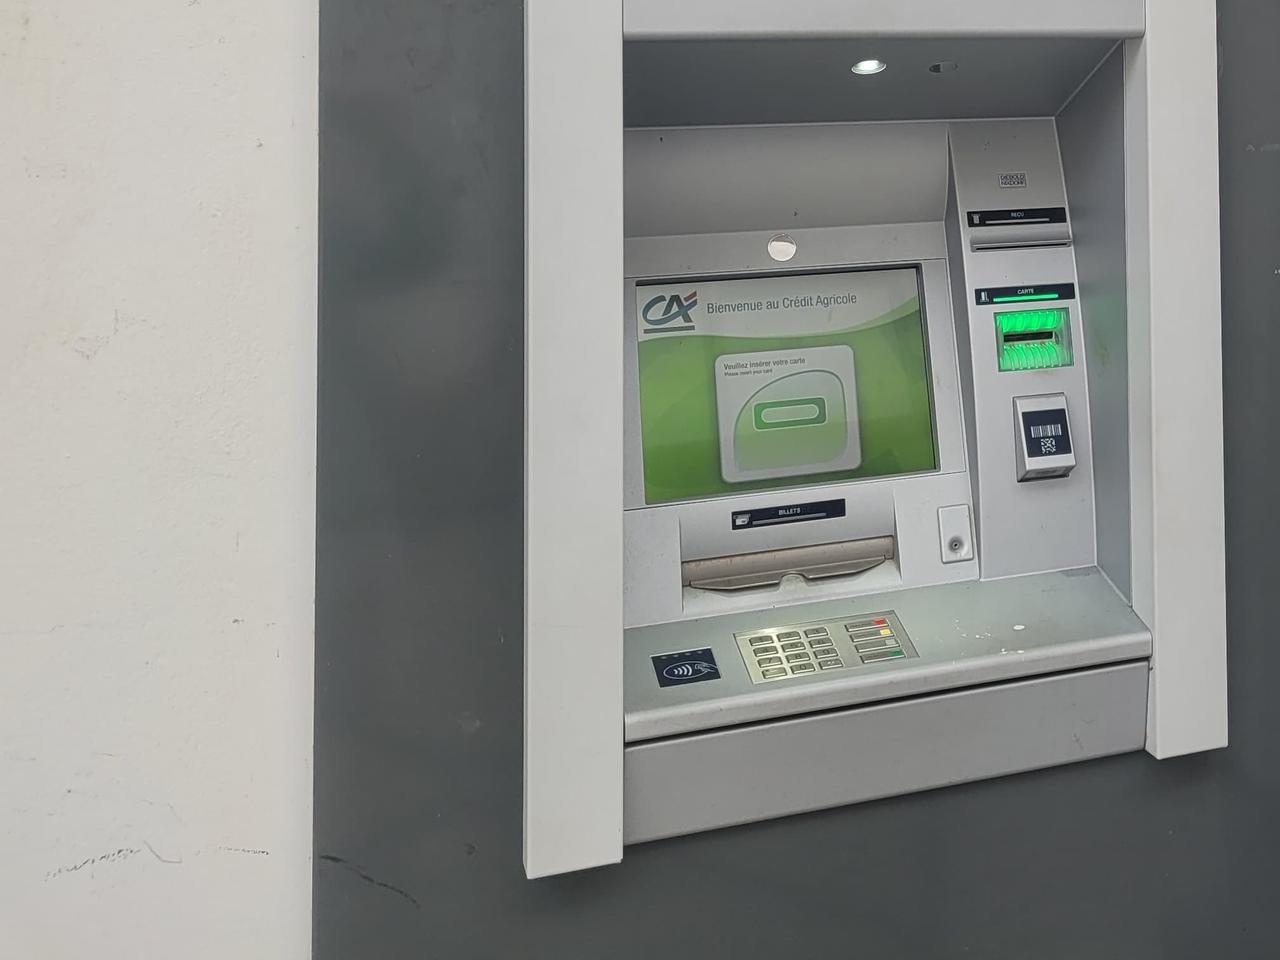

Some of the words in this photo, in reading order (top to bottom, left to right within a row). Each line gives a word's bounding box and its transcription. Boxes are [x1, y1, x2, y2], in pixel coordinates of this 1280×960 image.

[707, 299, 763, 314] Bienvenue
[766, 299, 779, 310] au
[782, 295, 813, 309] Crédit
[815, 292, 857, 307] Agricole
[723, 361, 748, 371] Veuillez
[749, 359, 772, 369] insérer
[772, 358, 789, 367] votre
[789, 357, 806, 365] carte
[778, 507, 801, 516] BILLETS
